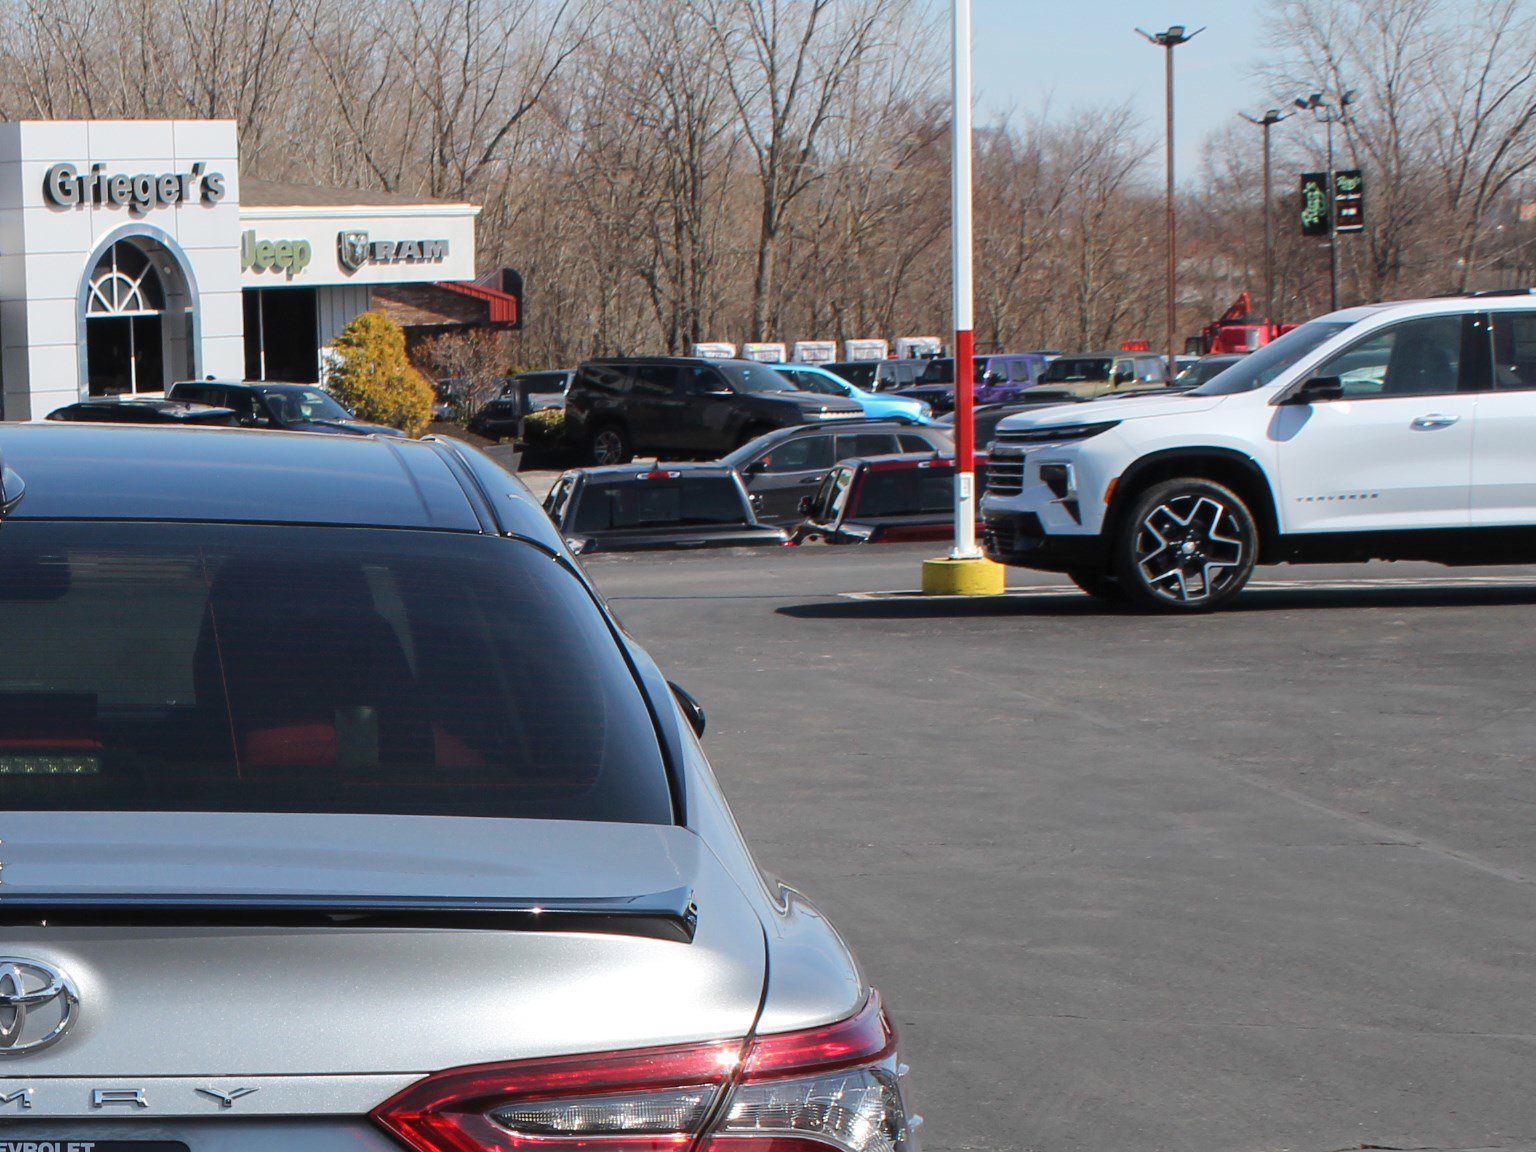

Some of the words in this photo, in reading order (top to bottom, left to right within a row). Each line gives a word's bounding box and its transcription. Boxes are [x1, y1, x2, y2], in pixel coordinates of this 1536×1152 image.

[44, 162, 226, 214] Grieger's
[241, 229, 312, 276] Jeep
[370, 239, 449, 261] RAM
